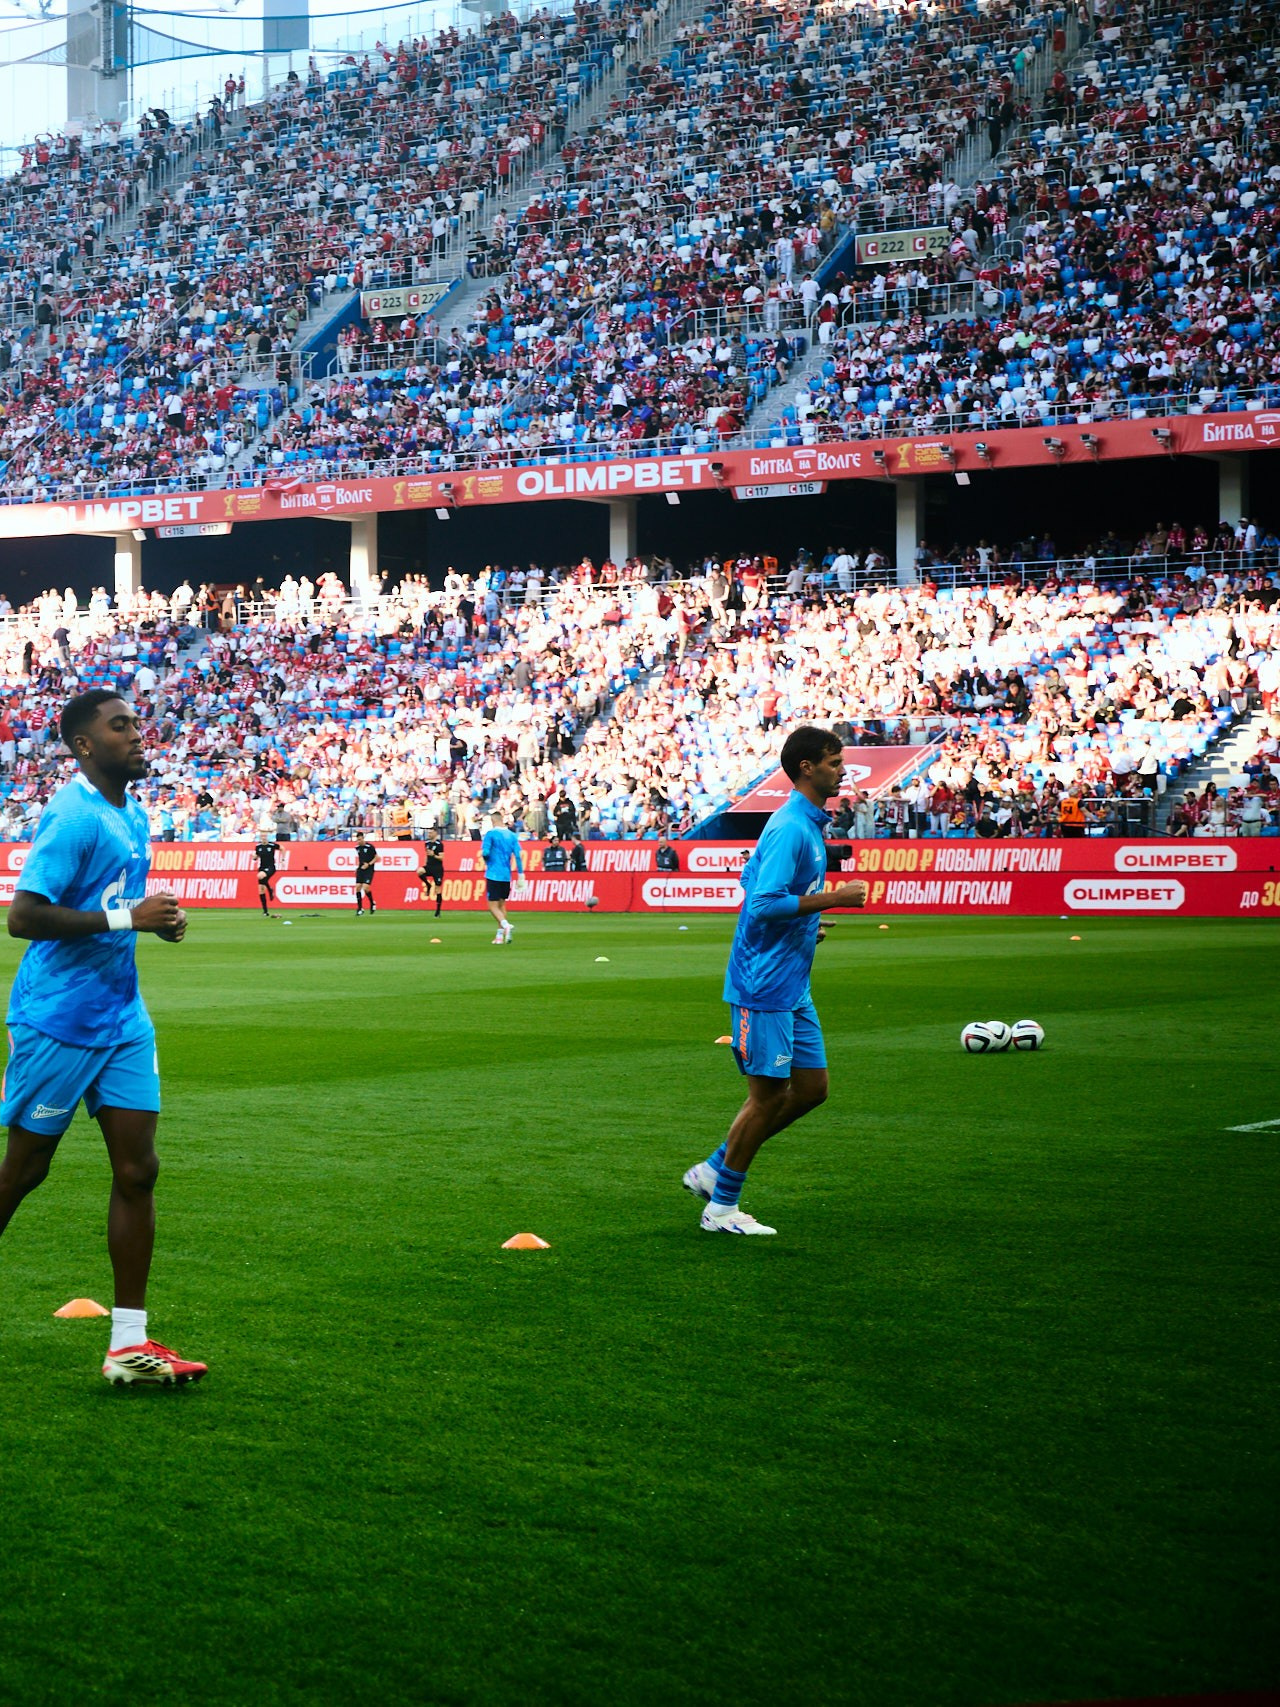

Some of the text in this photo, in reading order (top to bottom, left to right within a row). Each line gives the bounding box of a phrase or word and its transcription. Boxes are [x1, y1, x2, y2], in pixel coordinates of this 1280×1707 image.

[881, 240, 905, 254] 222
[383, 296, 402, 309] 223
[516, 458, 709, 496] OLIMPBET
[755, 487, 768, 496] 117
[800, 483, 814, 493] 116
[46, 496, 203, 530] OLIMPBET
[172, 526, 185, 536] 118
[207, 524, 219, 534] 117
[195, 850, 237, 871] НОВЫМ
[458, 858, 474, 872] до
[590, 850, 652, 871] ИГРОКАМ
[858, 849, 881, 872] 30
[882, 849, 917, 872] 000
[919, 849, 934, 872] ₽
[934, 848, 990, 872] НОВЫМ
[991, 848, 1063, 872] ИГРОКАМ
[1123, 855, 1228, 867] OLIMPBET
[187, 878, 239, 900] ИГРОКАМ
[282, 884, 356, 896] OLIMPBET
[404, 887, 419, 903] до
[440, 879, 472, 902] 000
[472, 879, 486, 902] ₽
[535, 880, 595, 902] ИГРОКАМ
[650, 887, 737, 898] OLIMPBET
[885, 880, 942, 905] НОВЫМ
[942, 881, 1013, 905] ИГРОКАМ
[1072, 887, 1176, 901] OLIMPBET
[1239, 890, 1259, 909] до
